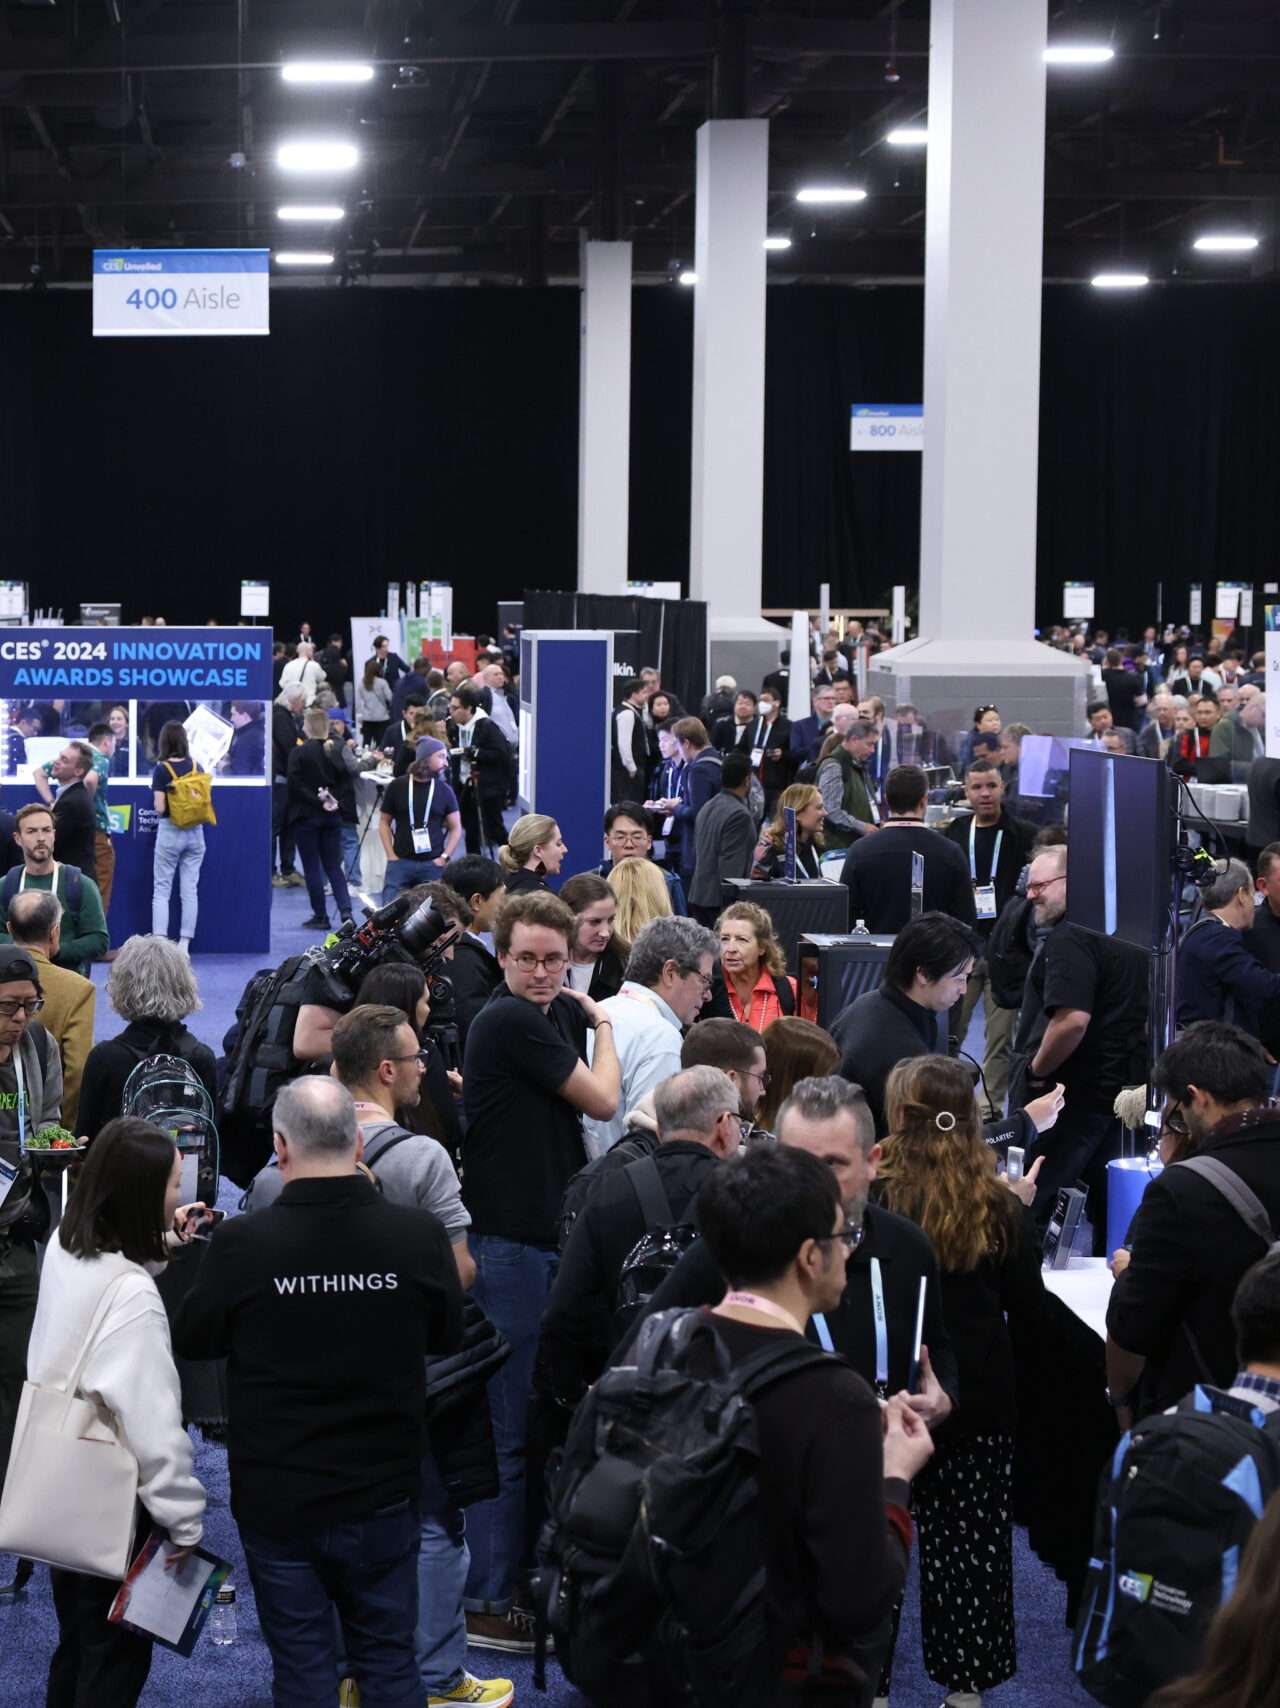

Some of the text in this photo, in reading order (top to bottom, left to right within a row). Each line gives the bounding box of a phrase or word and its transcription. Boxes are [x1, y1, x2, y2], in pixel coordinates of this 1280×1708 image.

[126, 285, 241, 310] 400 Aisle
[870, 424, 897, 437] 800
[53, 642, 107, 660] 2024
[113, 642, 261, 661] INNOVATION
[14, 668, 248, 686] AWARDS SHOWCASE
[273, 1273, 398, 1295] WITHINGS
